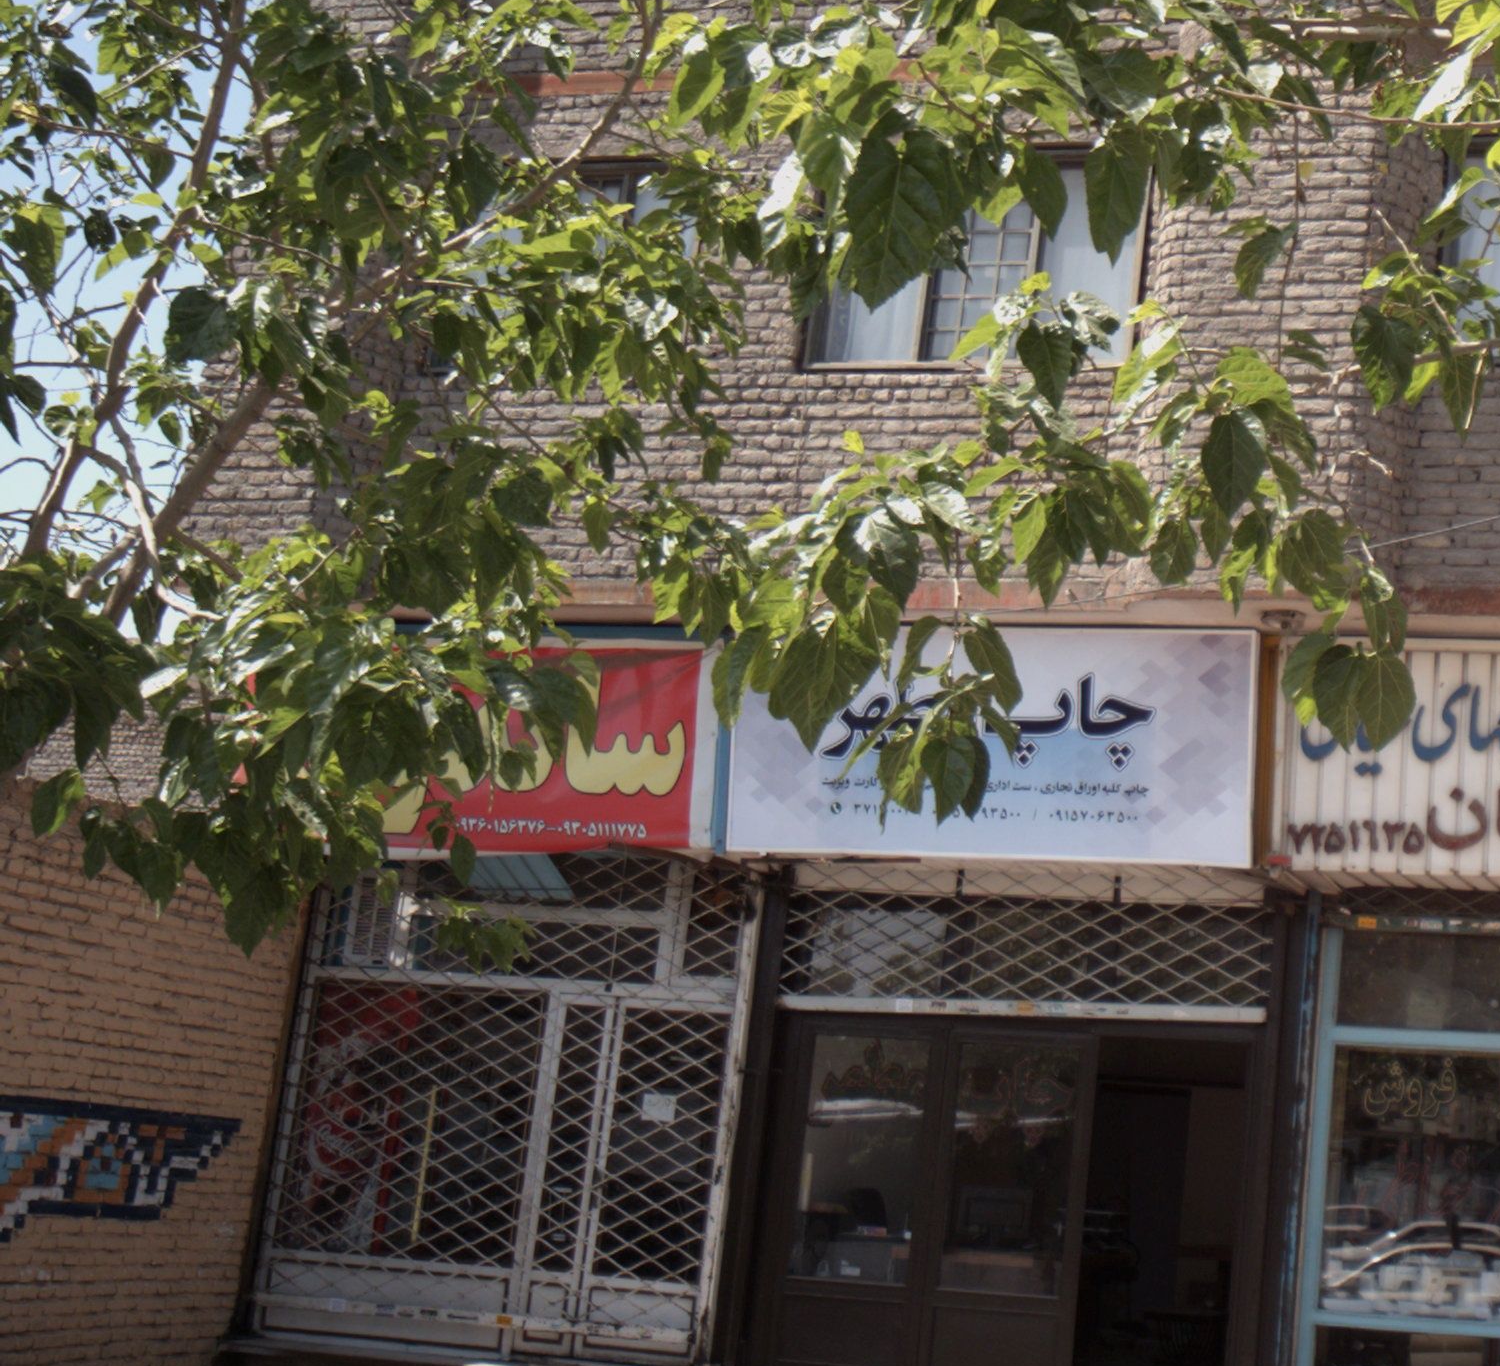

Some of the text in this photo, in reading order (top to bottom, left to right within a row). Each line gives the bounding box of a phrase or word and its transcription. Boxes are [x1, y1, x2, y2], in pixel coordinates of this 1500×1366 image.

[819, 672, 1156, 770] چاپ طهر
[1074, 781, 1101, 797] اوراق
[1362, 1057, 1458, 1118] فروش
